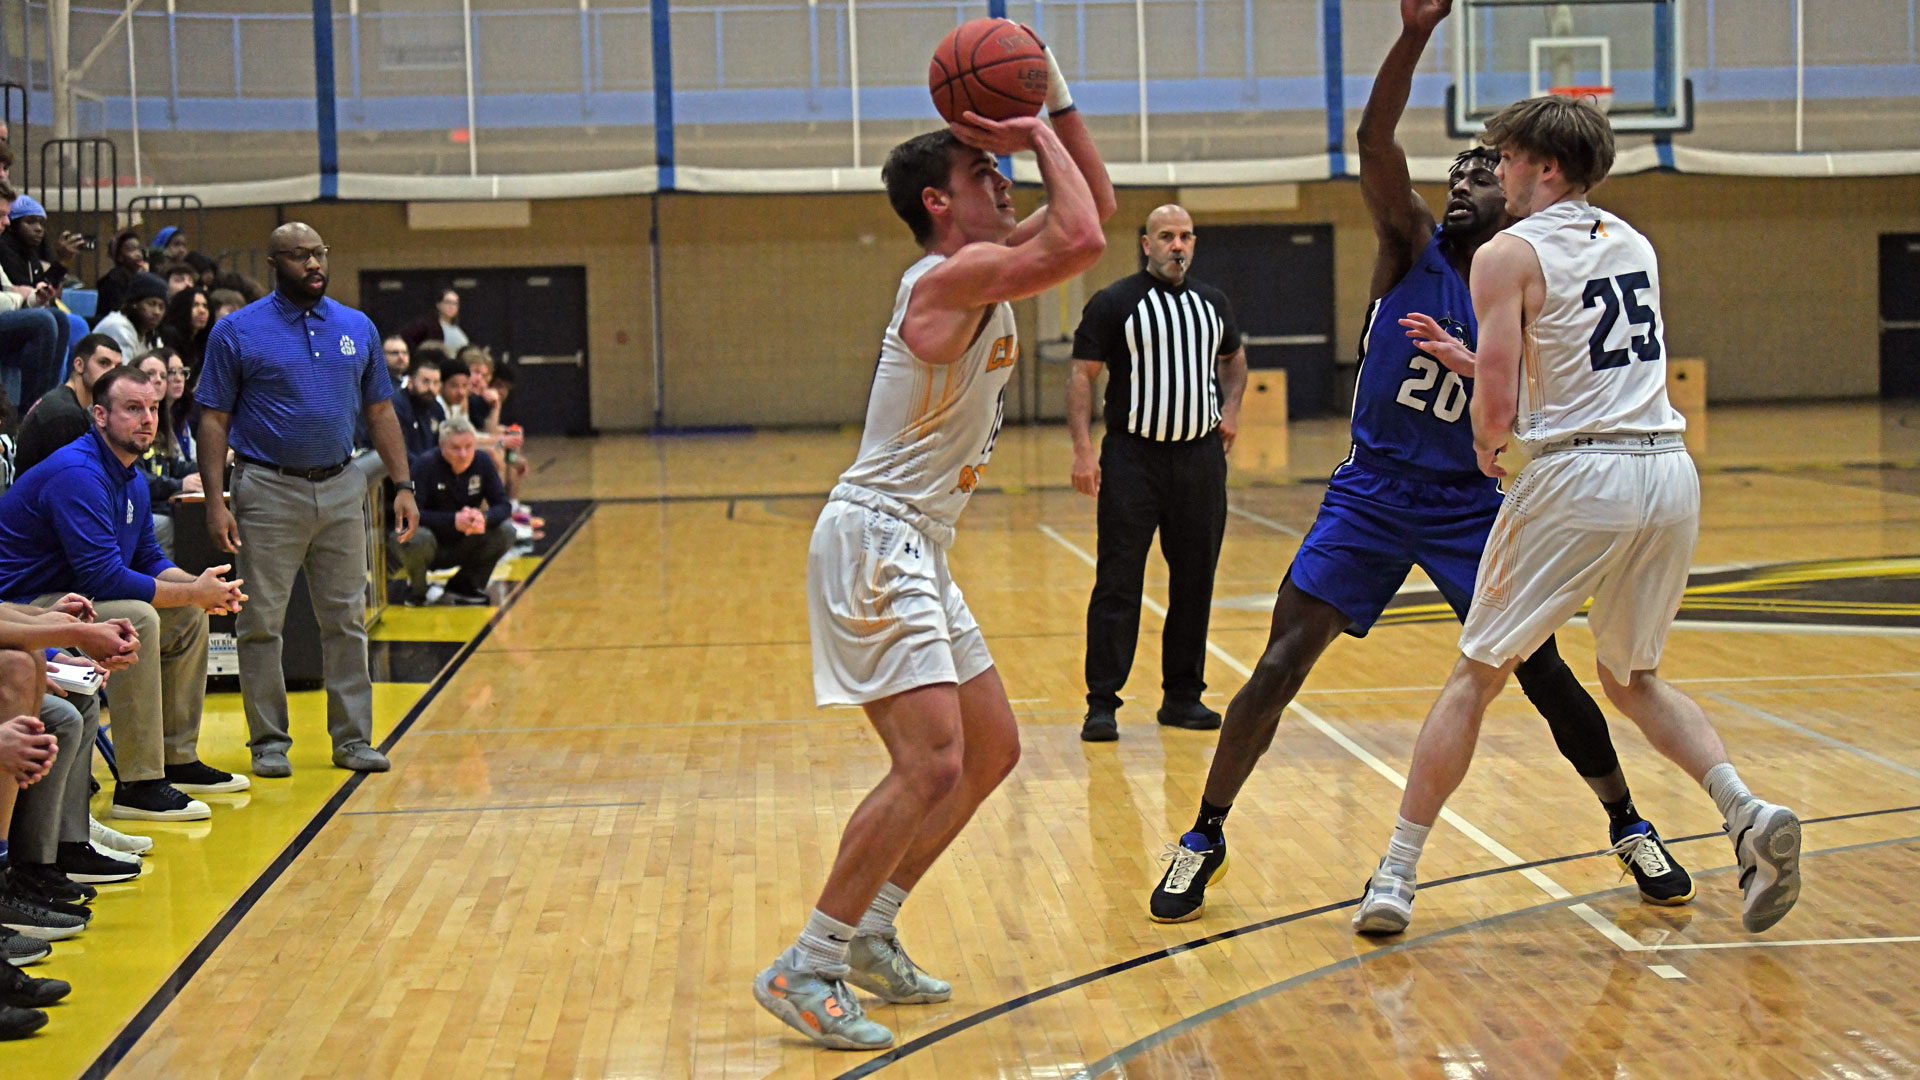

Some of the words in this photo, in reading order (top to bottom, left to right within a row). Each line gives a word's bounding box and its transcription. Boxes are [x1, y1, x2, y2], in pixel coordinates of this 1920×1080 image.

[986, 335, 1019, 373] CL
[1582, 271, 1661, 372] 25
[1395, 355, 1467, 423] 20
